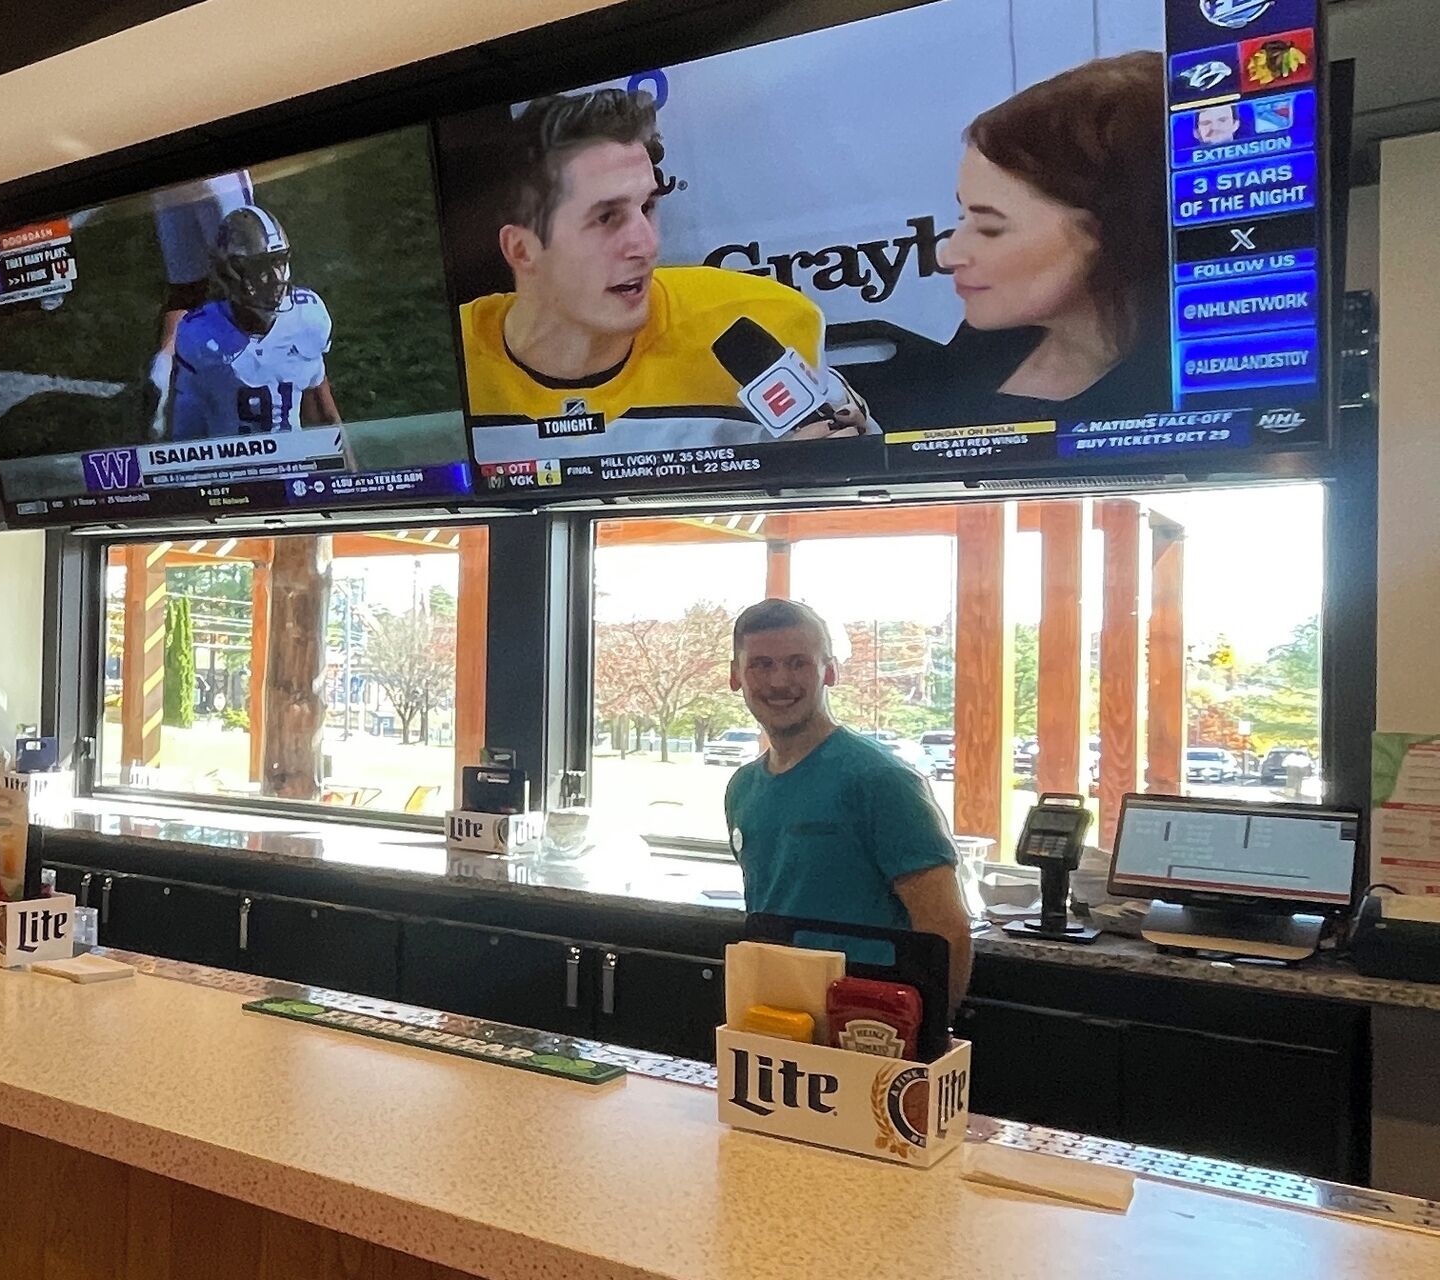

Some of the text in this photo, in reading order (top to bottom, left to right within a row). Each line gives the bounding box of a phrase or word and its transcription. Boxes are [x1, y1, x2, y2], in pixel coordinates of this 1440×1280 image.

[1192, 136, 1292, 163] EXTENSION
[1193, 165, 1293, 194] 3 STARS
[1180, 185, 1308, 218] OF THE NIGHT
[1193, 254, 1295, 279] FOLLOW US
[1183, 292, 1308, 319] @NHLNETWORK
[1089, 412, 1233, 432] NATIONS FACE-OFF
[1256, 411, 1306, 429] NHL
[912, 434, 1029, 451] OILERS AT RED WINGS
[923, 429, 965, 439] SUNDAY
[967, 428, 982, 437] ON
[1076, 429, 1231, 449] BUY TICKETS OCT 29
[149, 439, 277, 466] ISAIAH WARD
[600, 457, 624, 468] HILL
[680, 451, 694, 463] 35
[695, 448, 735, 461] SAVES
[89, 450, 131, 490] W
[508, 461, 553, 474] OTT 4
[567, 465, 594, 475] FINAL
[601, 466, 654, 480] ULLMARK
[704, 461, 718, 473] 22
[721, 458, 761, 472] SAVES
[374, 472, 402, 486] TEXAS
[508, 473, 554, 487] VGK 6
[450, 814, 483, 842] Lite
[16, 909, 69, 953] Lite
[857, 1028, 886, 1040] HEINZ
[728, 1047, 840, 1117] Lite
[935, 1069, 967, 1140] Lite
